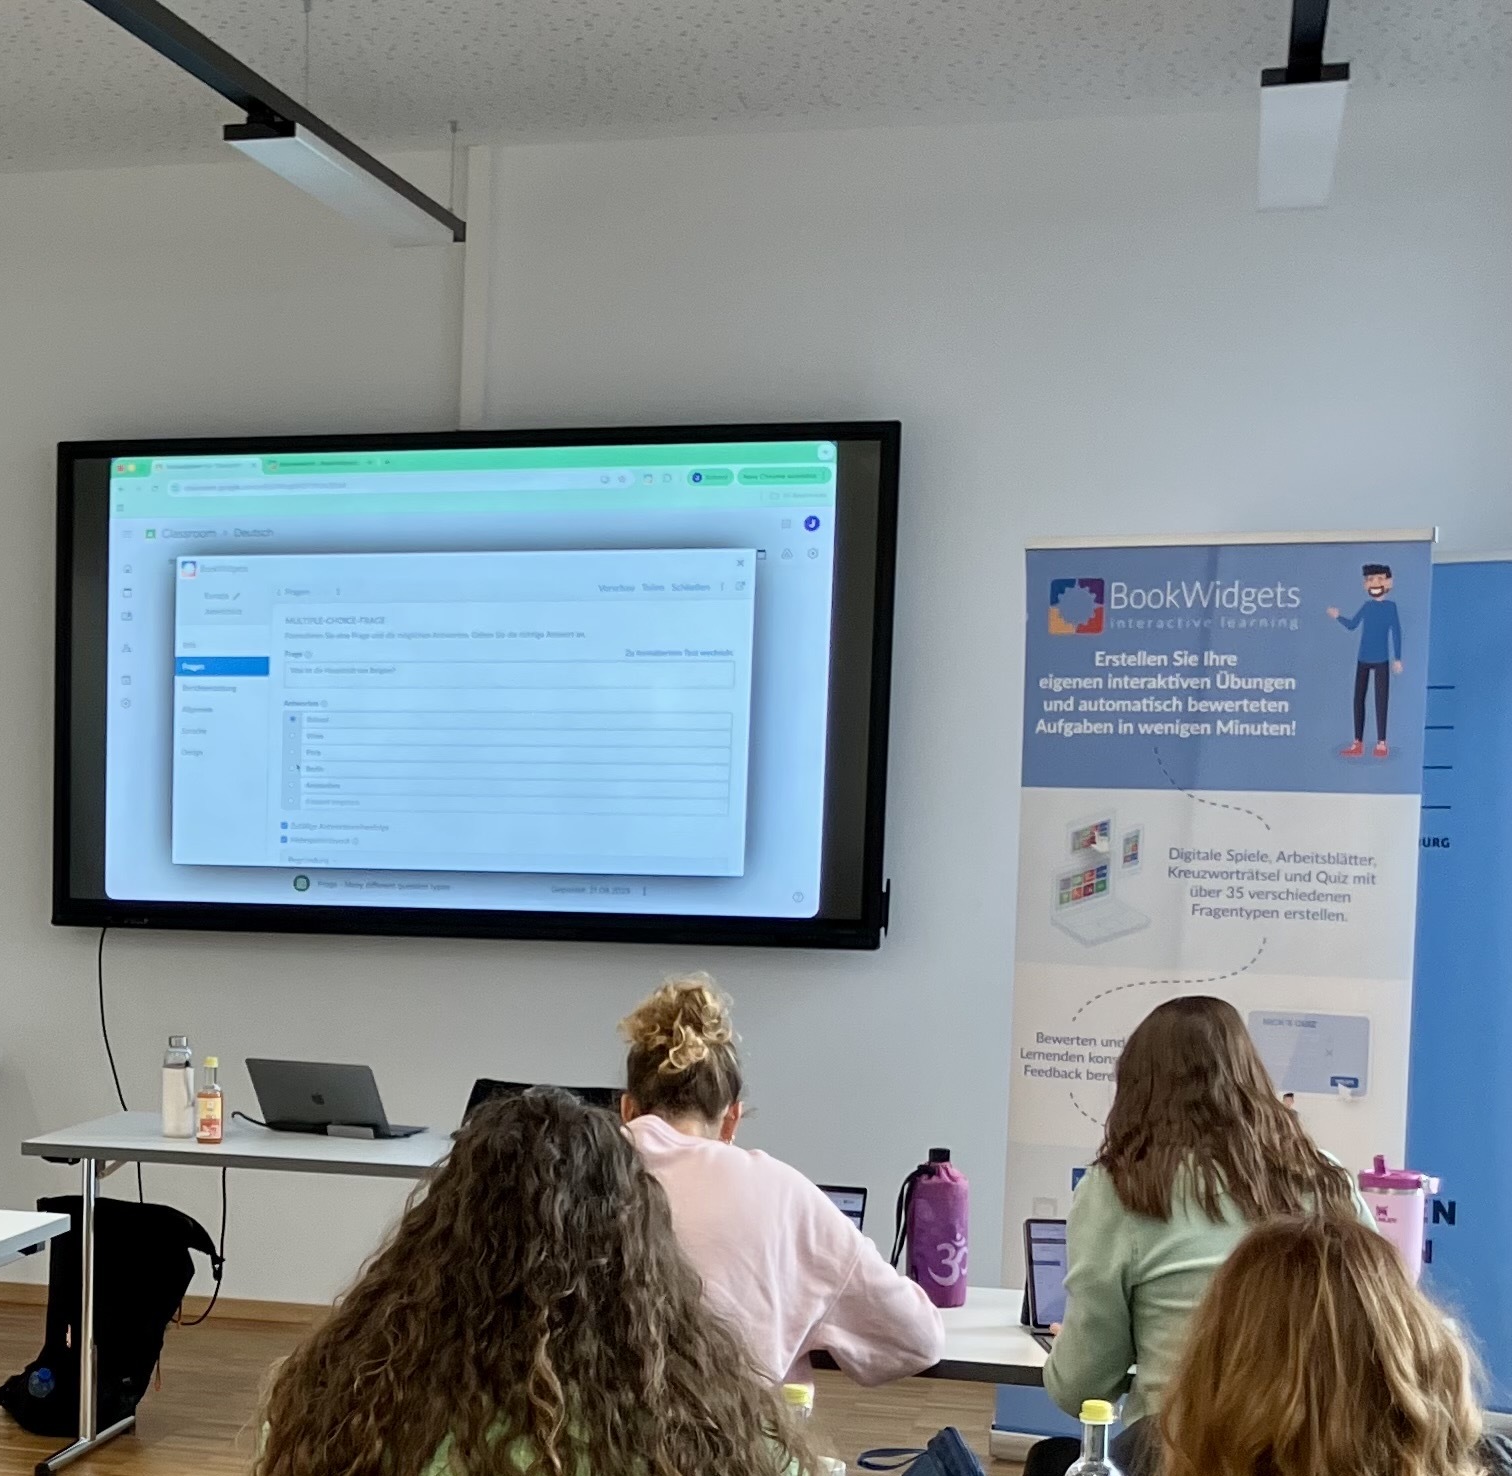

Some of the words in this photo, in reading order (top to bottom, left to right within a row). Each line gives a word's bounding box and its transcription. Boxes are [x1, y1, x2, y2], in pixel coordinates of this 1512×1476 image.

[162, 528, 217, 539] Classroom
[233, 527, 275, 538] Deutsch
[1110, 580, 1301, 615] BookWidgets
[1110, 617, 1212, 630] interactive
[1220, 617, 1300, 632] learning
[1094, 650, 1168, 667] Erstellen
[1172, 650, 1199, 667] Sie
[1203, 650, 1238, 667] Ihre
[1039, 673, 1103, 692] eigenen
[1107, 672, 1211, 690] interaktiven
[1215, 670, 1297, 693] Übungen
[1043, 696, 1074, 712] und
[1078, 696, 1182, 713] automatisch
[1187, 696, 1289, 713] bewerteten
[1035, 718, 1114, 737] Aufgaben
[1118, 719, 1134, 735] in
[1138, 719, 1212, 738] wenigen
[1216, 719, 1297, 737] Minuten!
[1419, 837, 1451, 849] URG
[1168, 847, 1222, 863] Digitale
[1226, 849, 1273, 864] Spiele,
[1276, 850, 1378, 868] Arbeitsblätter,
[1167, 866, 1281, 883] Kreuzworträtsel
[1284, 869, 1312, 883] und
[1315, 870, 1348, 886] Quiz
[1352, 872, 1377, 886] mit
[1189, 886, 1223, 899] über
[1226, 886, 1245, 900] 35
[1248, 887, 1351, 904] verschiedenen
[1191, 903, 1280, 921] Fragentypen
[1283, 907, 1348, 923] erstellen.
[1036, 1031, 1097, 1047] Bewerten
[1100, 1037, 1126, 1048] und
[1019, 1047, 1085, 1063] Lernenden
[1023, 1064, 1083, 1080] Feedback
